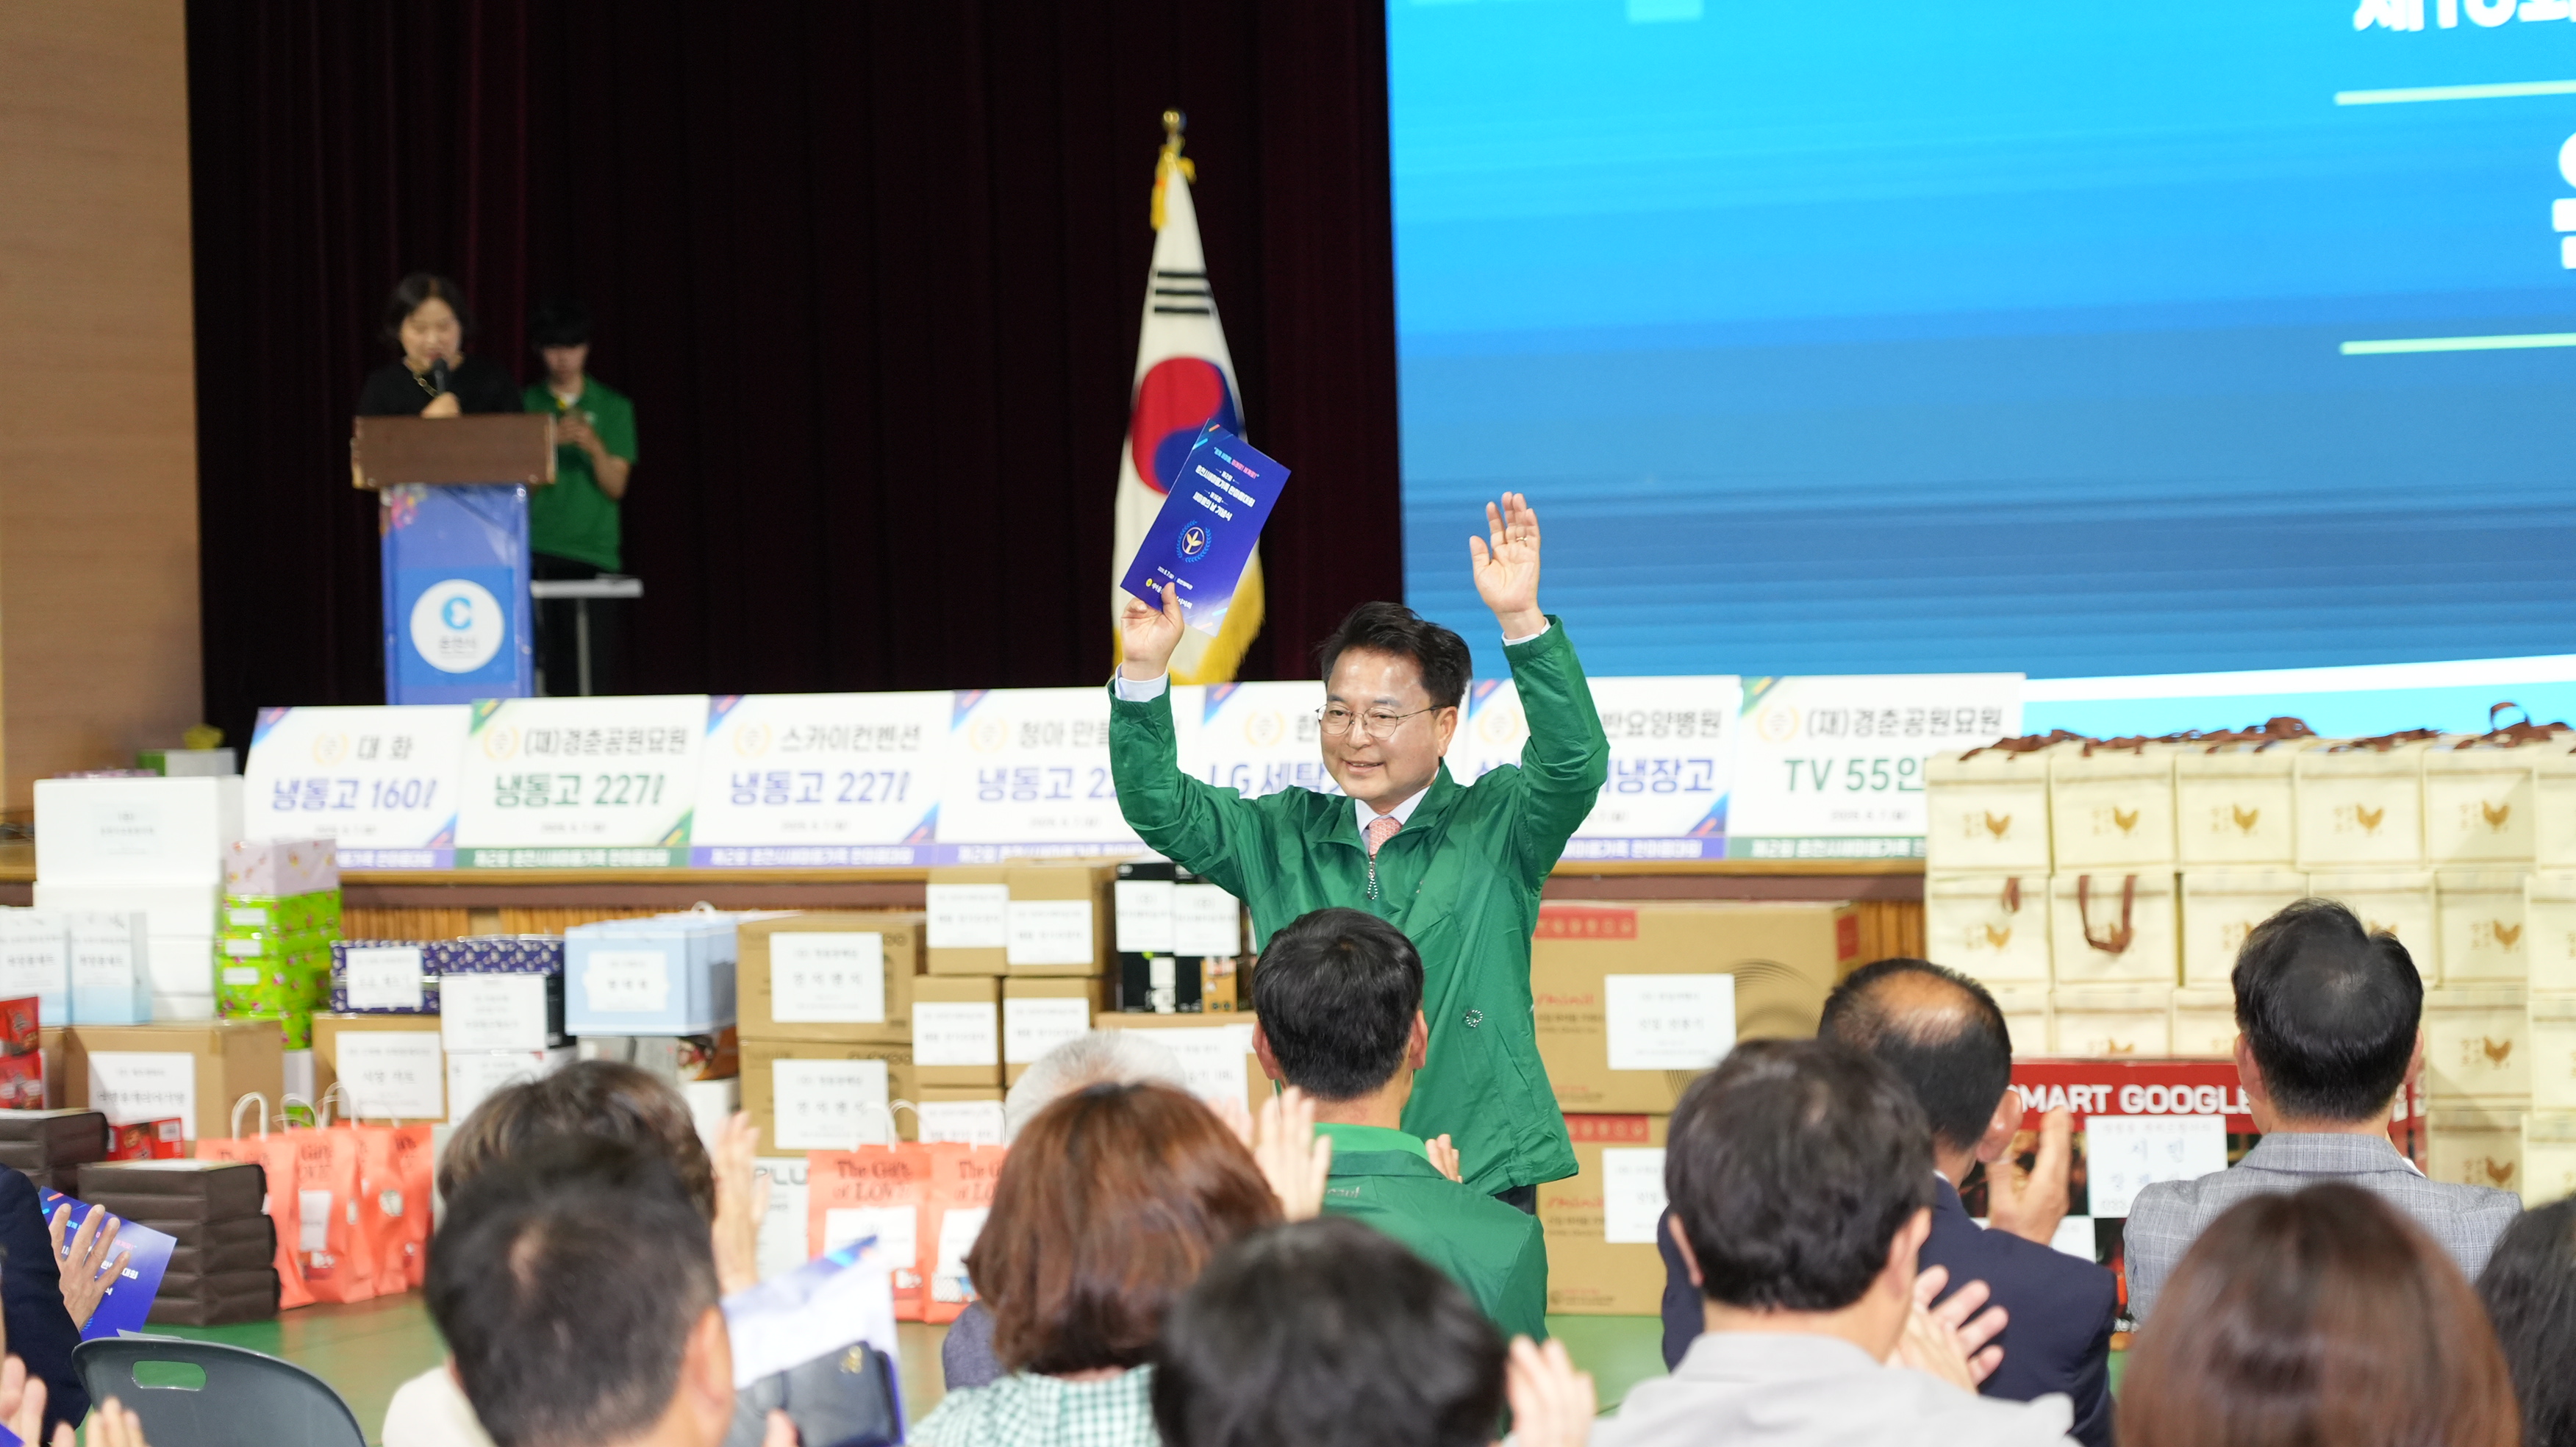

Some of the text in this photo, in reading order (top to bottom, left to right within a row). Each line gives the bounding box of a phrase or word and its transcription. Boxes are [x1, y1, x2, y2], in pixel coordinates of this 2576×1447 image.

[779, 724, 920, 752] 스카이컨벤션
[1602, 710, 1722, 738] 반요양병원
[495, 773, 581, 808] 냉동고
[731, 771, 823, 805] 냉동고
[979, 768, 1073, 801] 냉동고
[1260, 762, 1341, 794] 세탁
[1605, 759, 1714, 793] 냉장고
[1784, 758, 1925, 791] TV 55인
[273, 778, 359, 810] 냉동고
[837, 1159, 867, 1179] The
[959, 1160, 985, 1180] The
